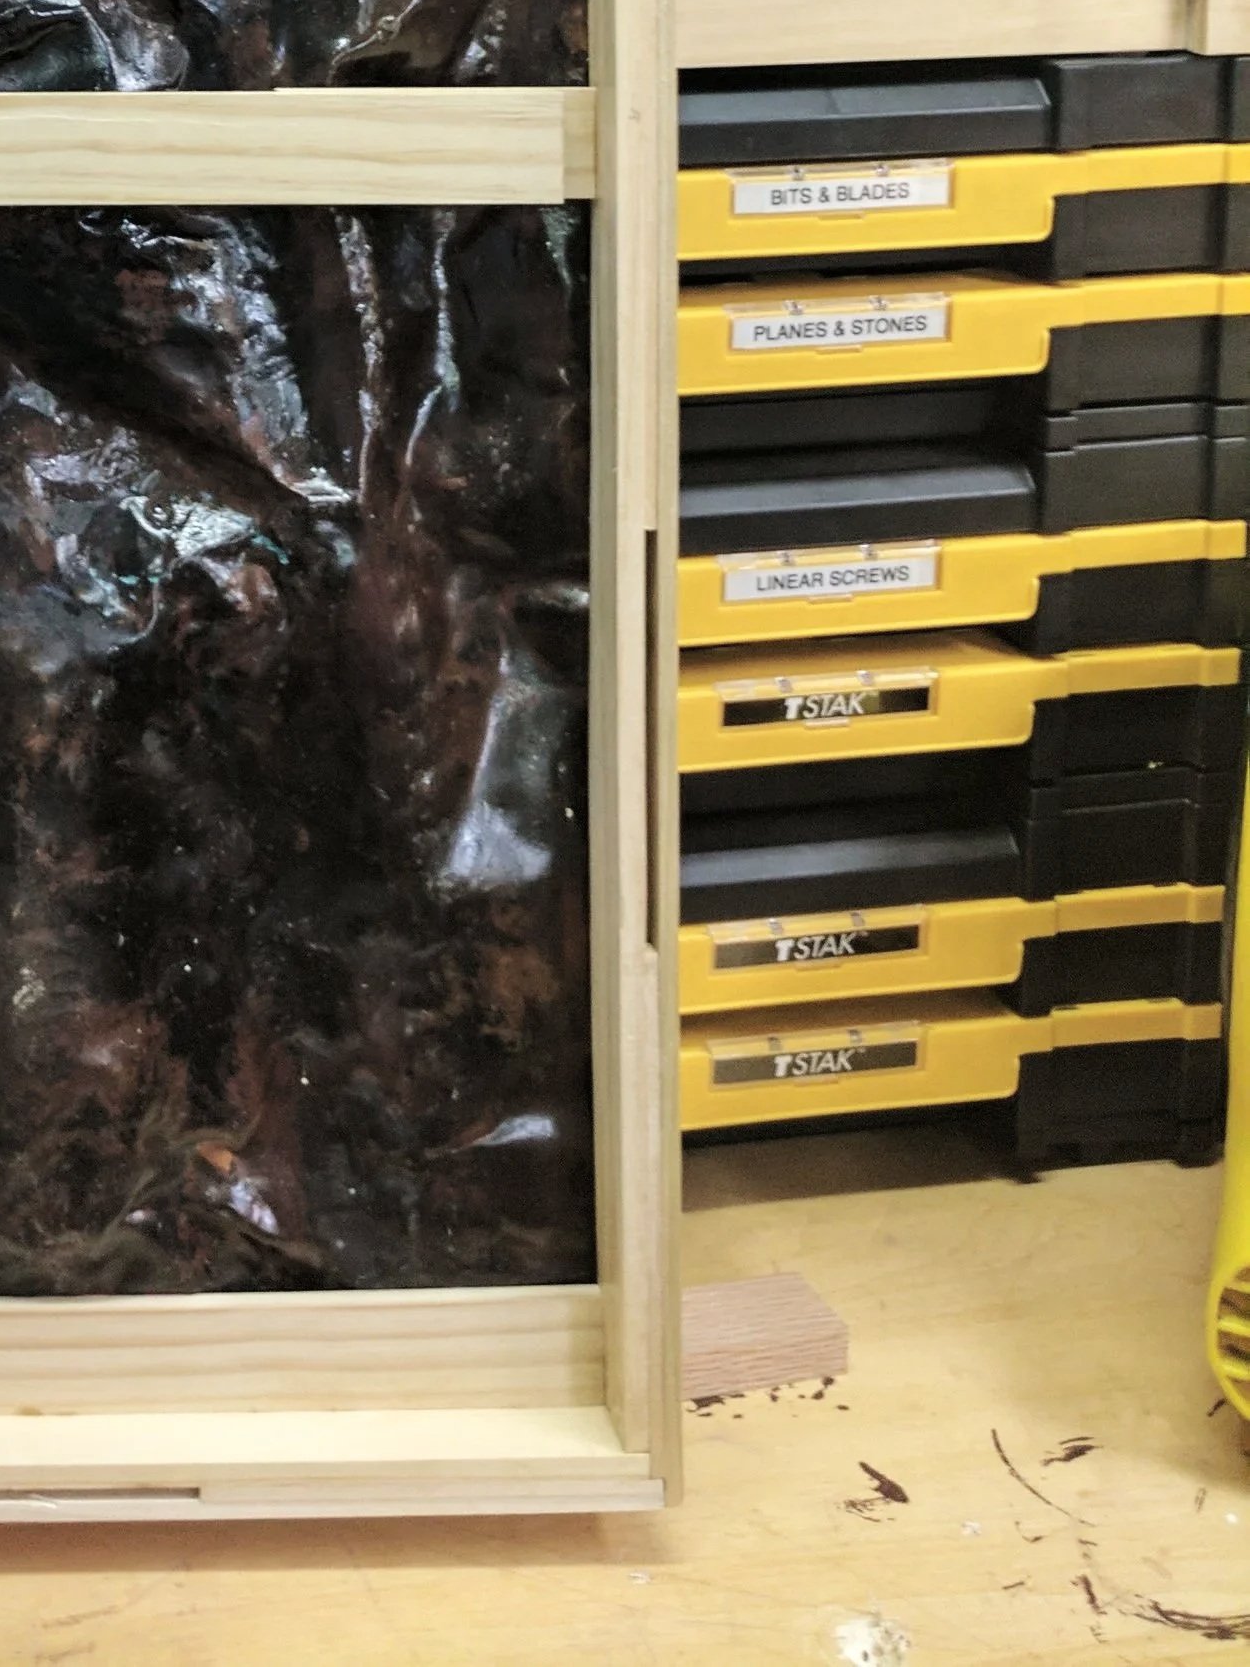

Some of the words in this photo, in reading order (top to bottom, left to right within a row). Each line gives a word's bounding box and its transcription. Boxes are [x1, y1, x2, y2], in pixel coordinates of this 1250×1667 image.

[770, 187, 812, 206] BITS
[818, 186, 831, 203] &
[837, 182, 910, 203] BLADES
[754, 320, 828, 342] PLANES
[833, 321, 845, 337] &
[851, 315, 928, 336] STONES
[756, 569, 824, 592] LINEAR
[829, 565, 910, 587] SCREWS
